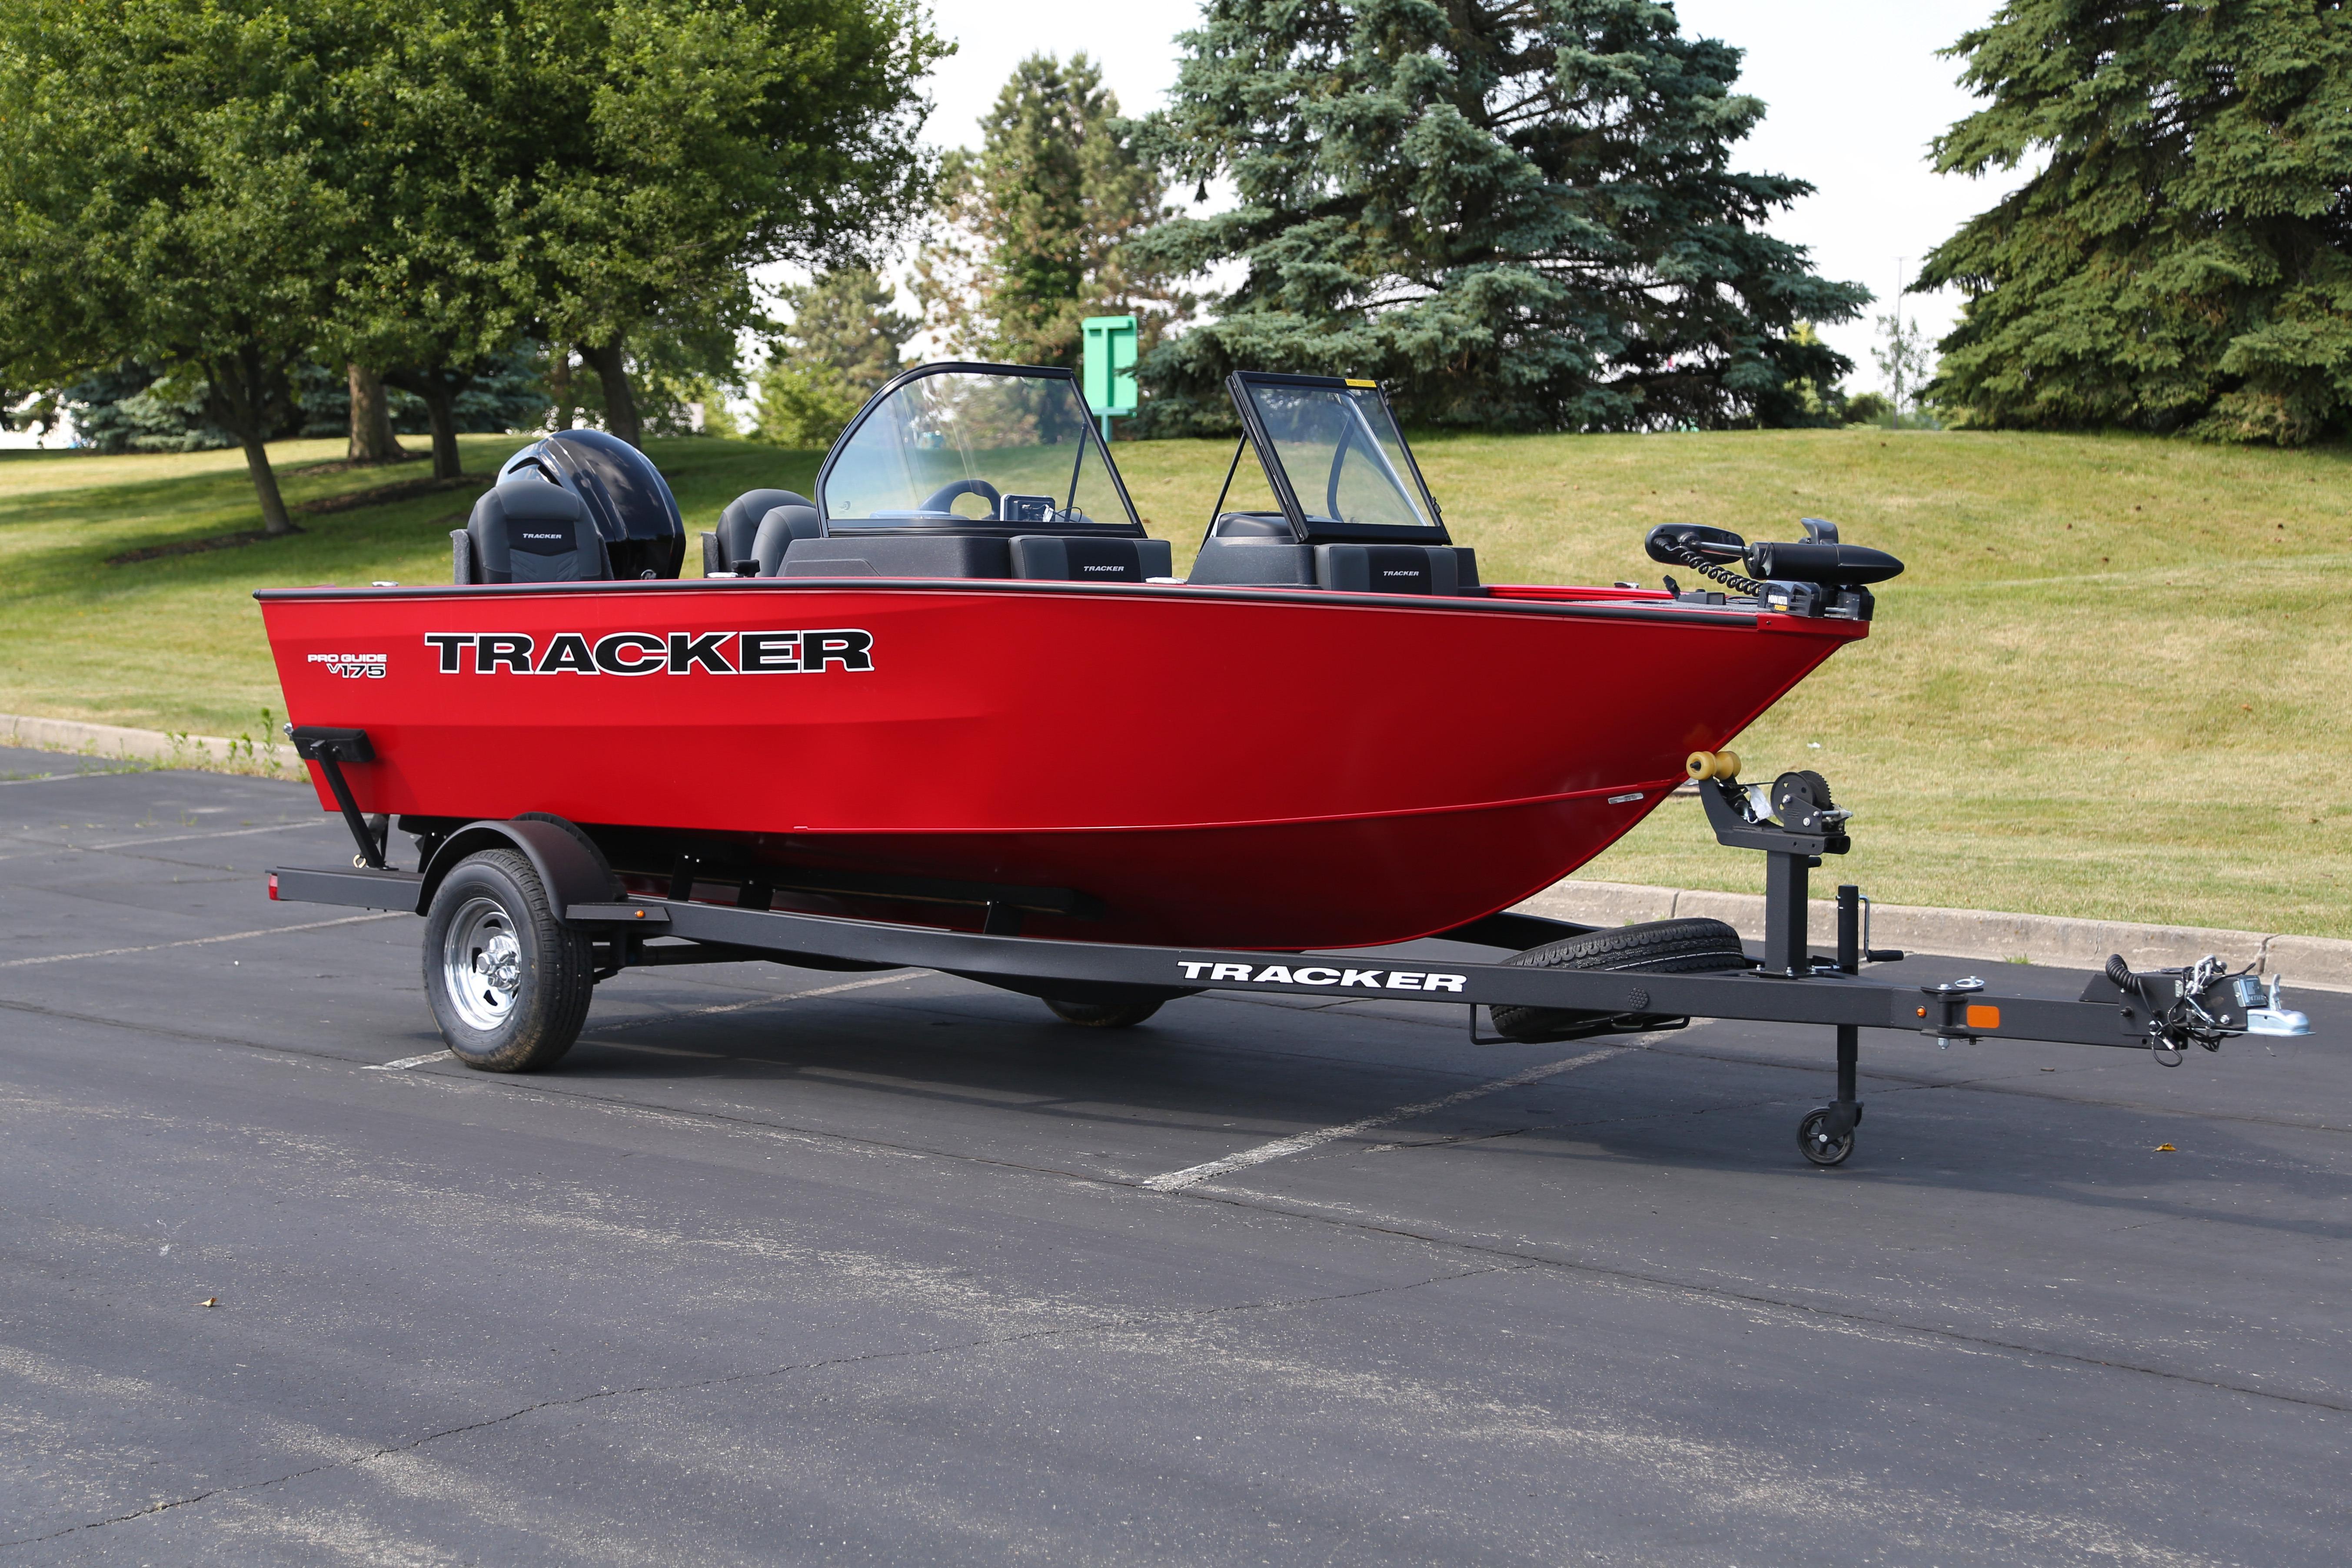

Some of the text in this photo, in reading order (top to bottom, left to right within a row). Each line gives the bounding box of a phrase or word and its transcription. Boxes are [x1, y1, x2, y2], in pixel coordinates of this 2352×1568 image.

[307, 654, 387, 662] PRO GUIDE
[424, 629, 875, 676] TRACKER
[326, 663, 386, 679] V175
[1177, 961, 1468, 992] TRACKER
